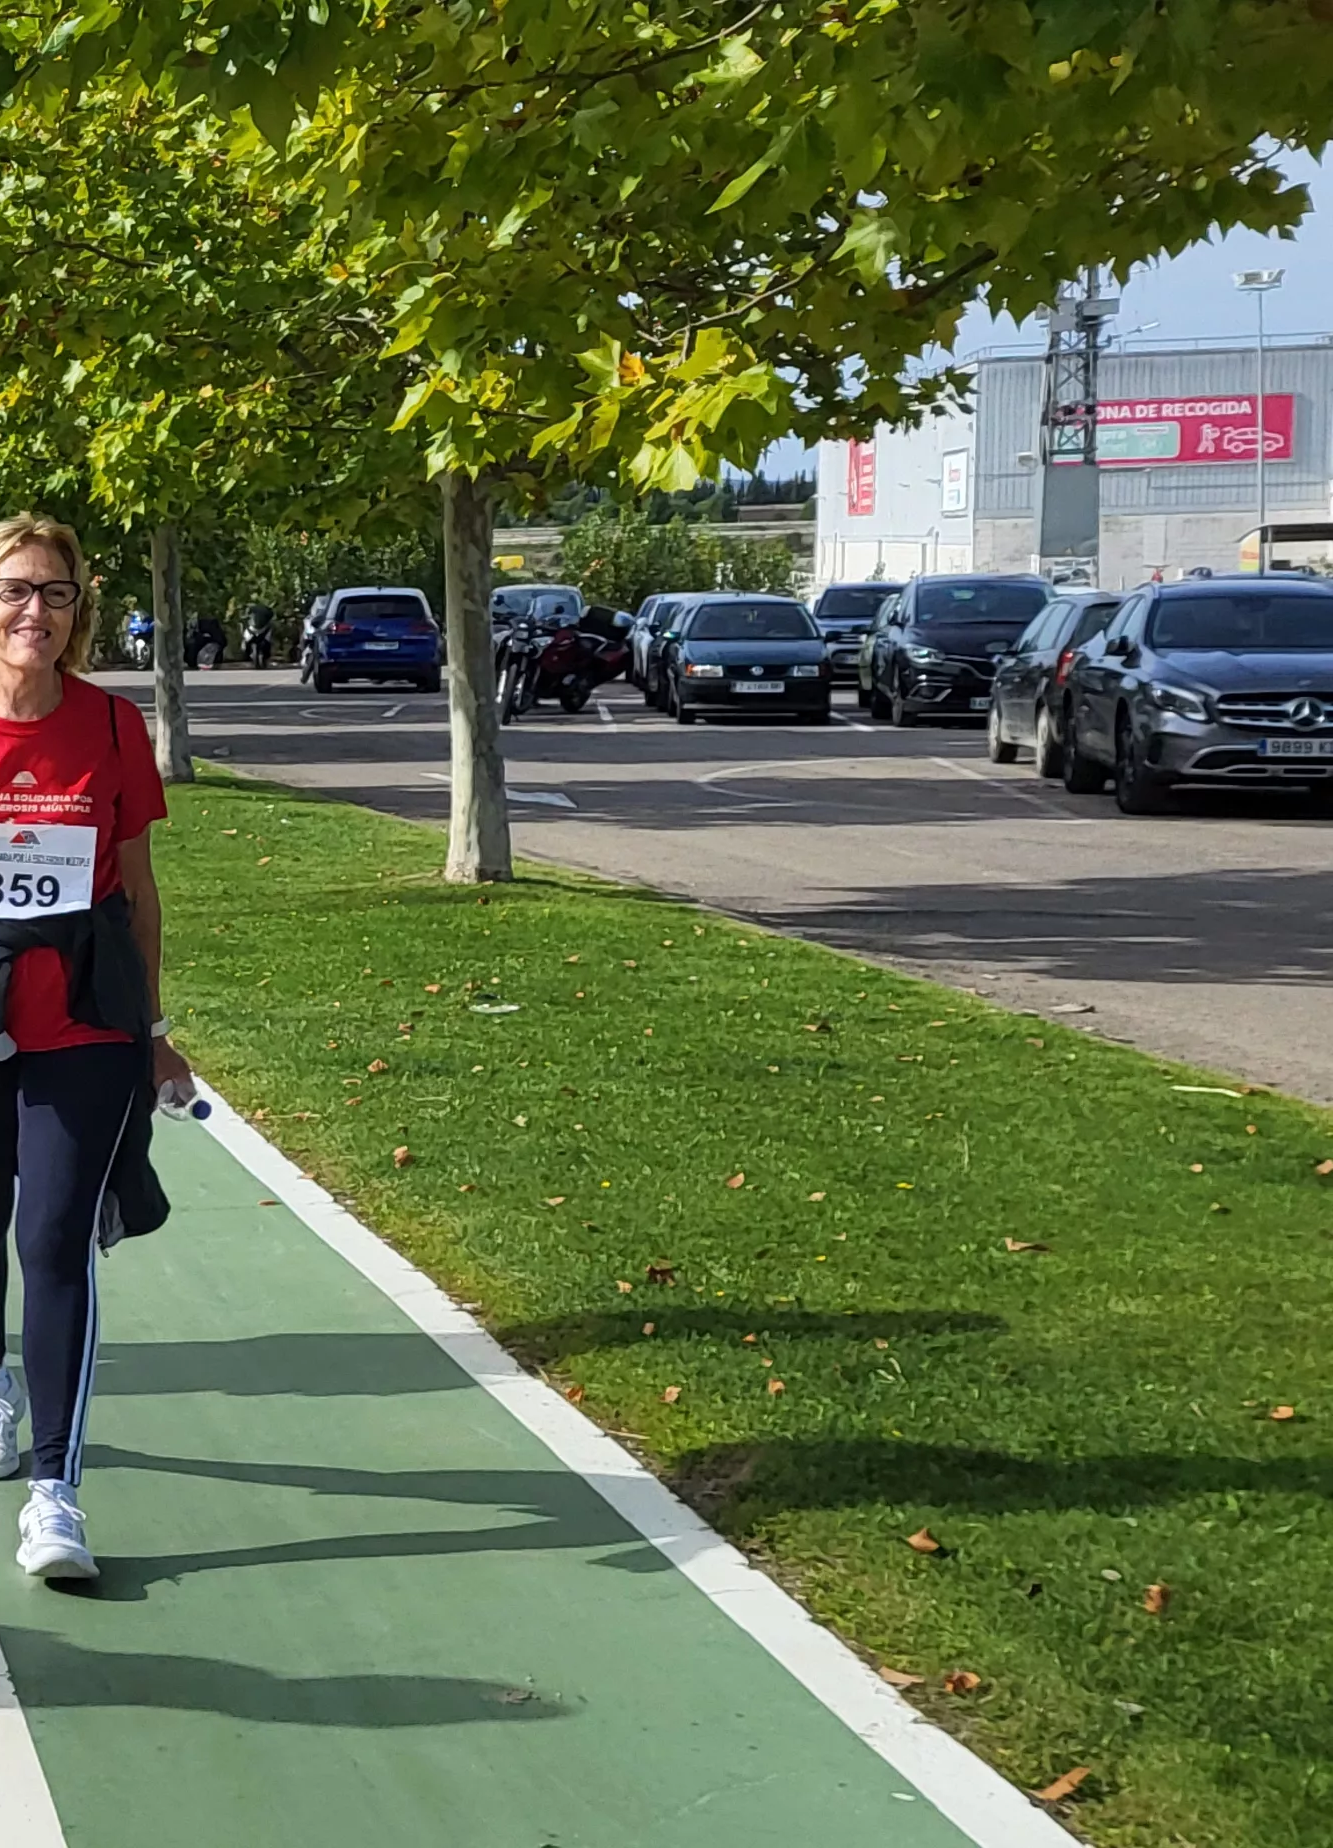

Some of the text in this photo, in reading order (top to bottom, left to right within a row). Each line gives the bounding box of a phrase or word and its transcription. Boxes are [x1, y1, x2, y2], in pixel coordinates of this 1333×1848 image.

[1135, 403, 1158, 418] DE
[1161, 400, 1252, 417] RECOGIDA
[13, 794, 71, 803] SOLIDARIA
[72, 794, 93, 804] POR
[39, 802, 91, 814] MÚLTIPLE
